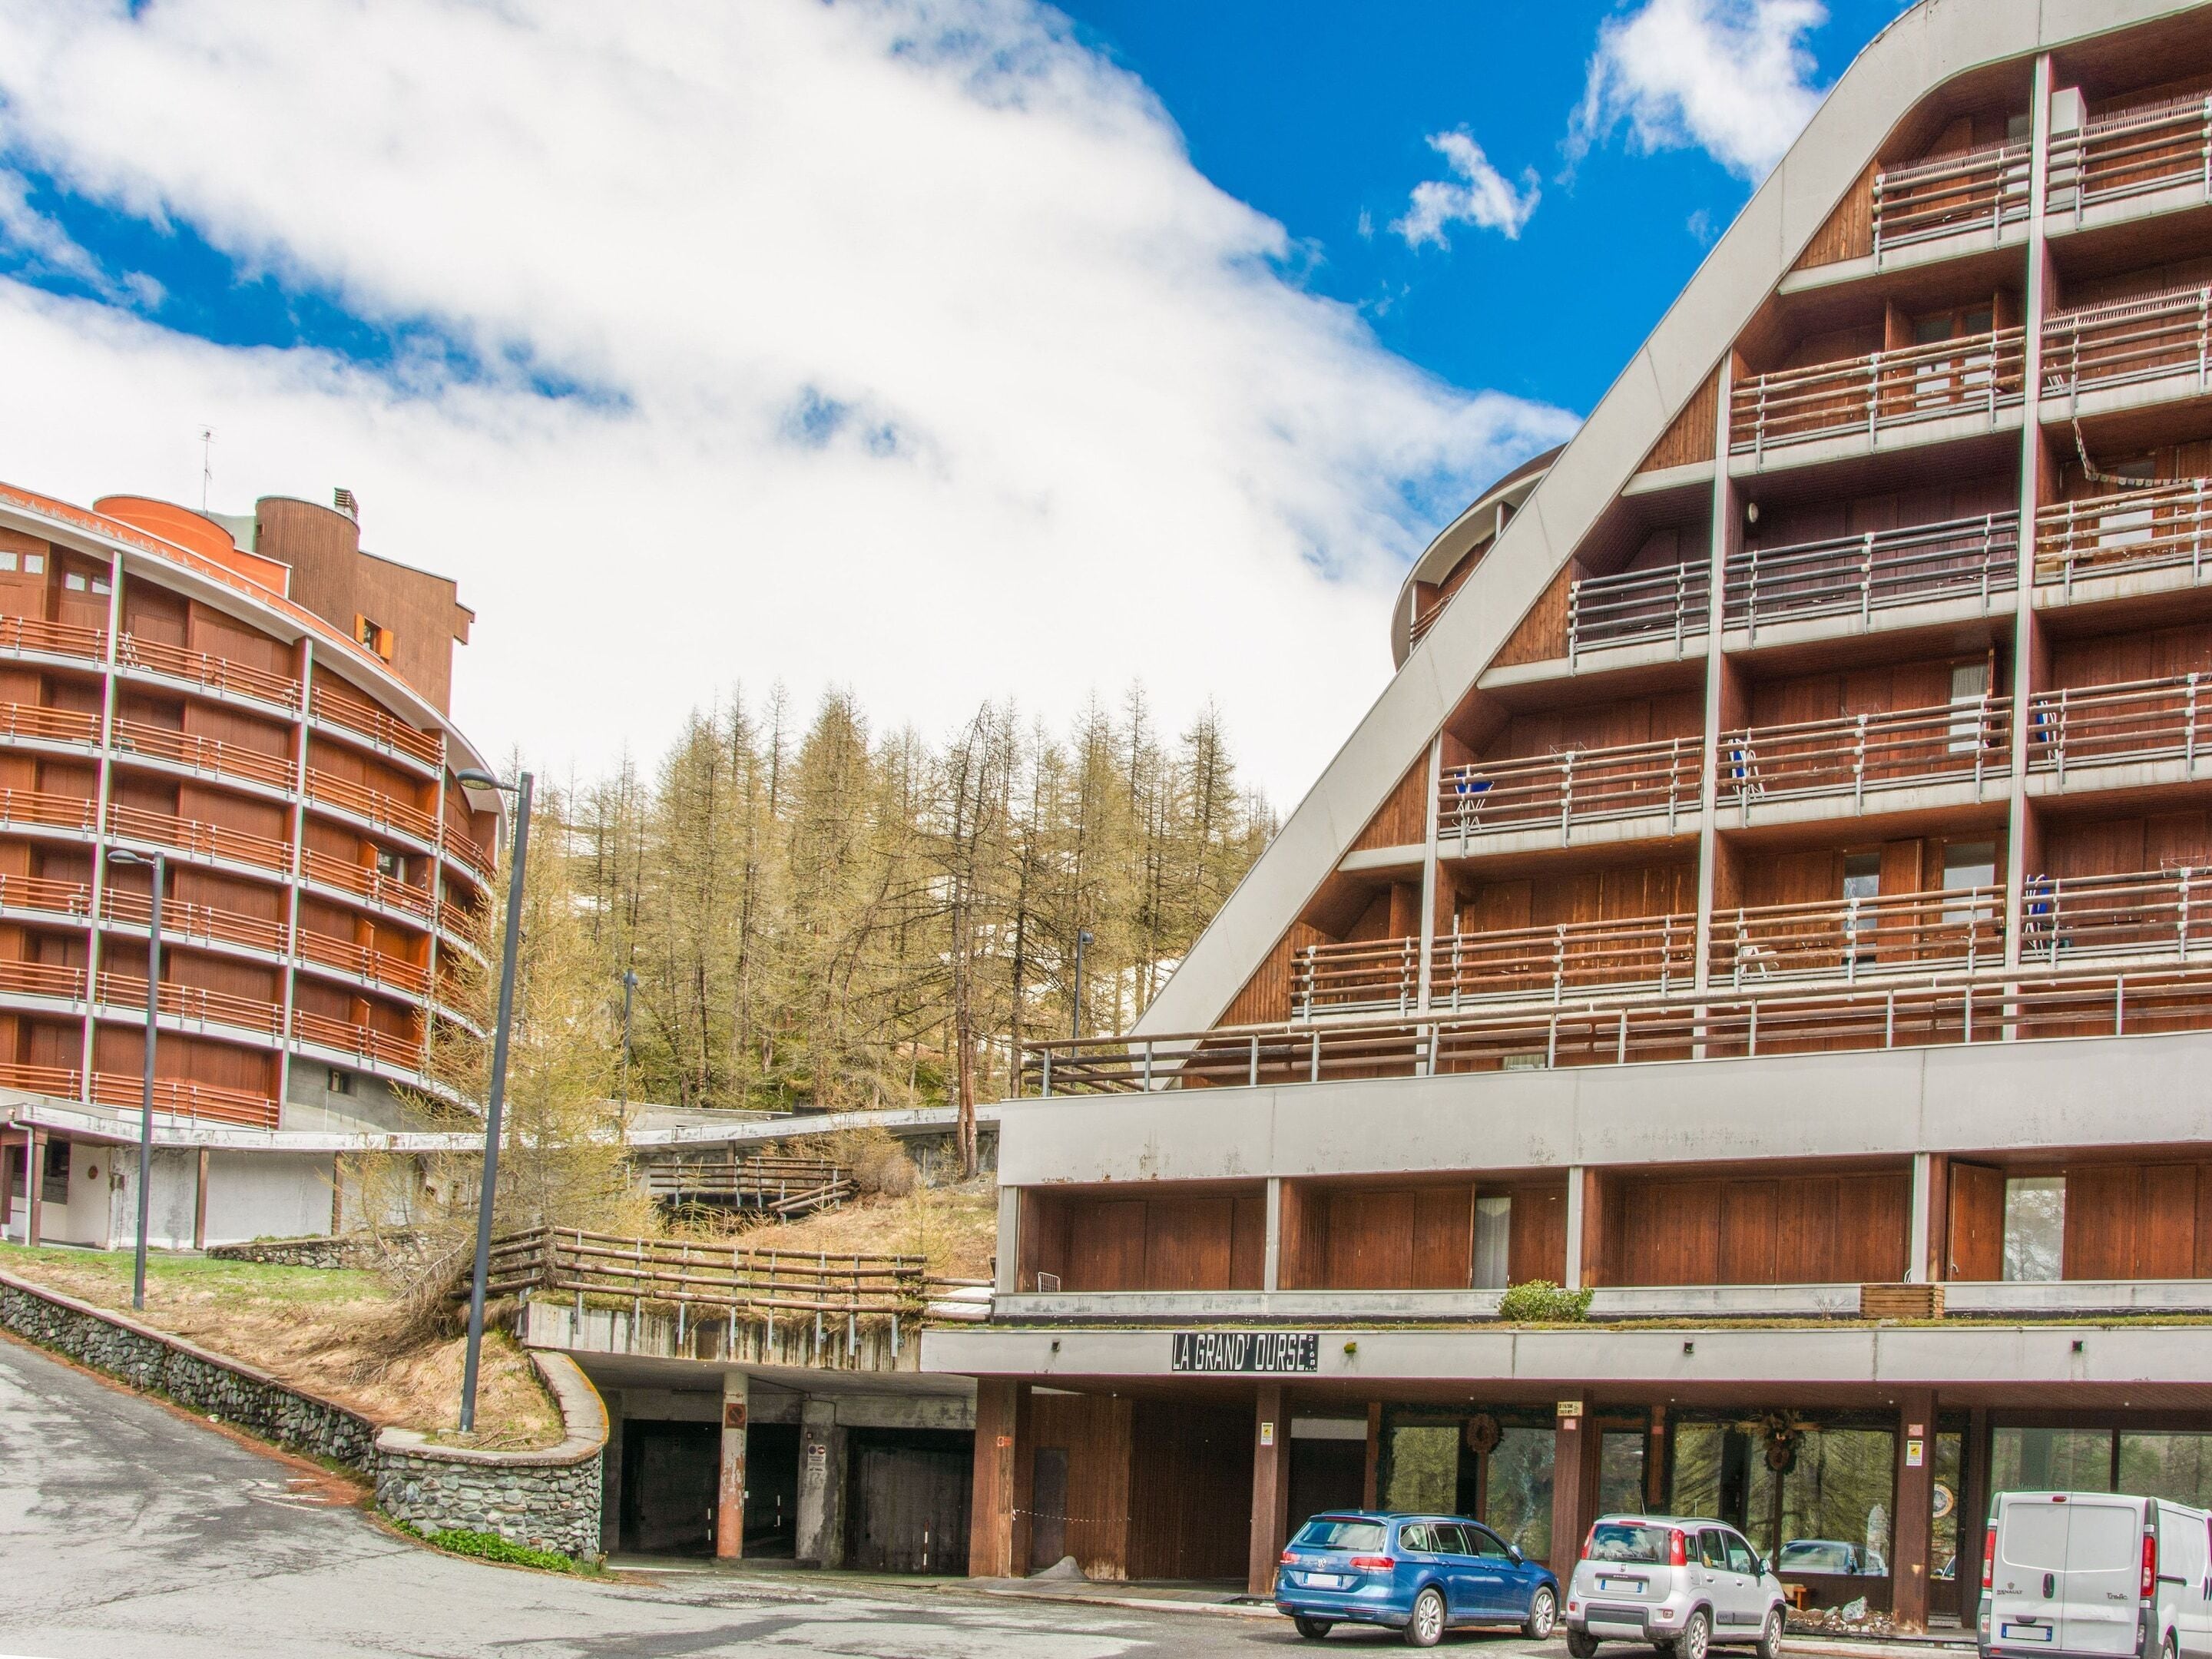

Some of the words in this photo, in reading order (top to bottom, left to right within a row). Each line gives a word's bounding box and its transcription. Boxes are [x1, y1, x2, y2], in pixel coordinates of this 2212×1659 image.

[1173, 1333, 1189, 1370] LA
[1195, 1333, 1250, 1371] GRAND'
[1255, 1333, 1307, 1371] OURSE
[2016, 1482, 2042, 1491] Maison
